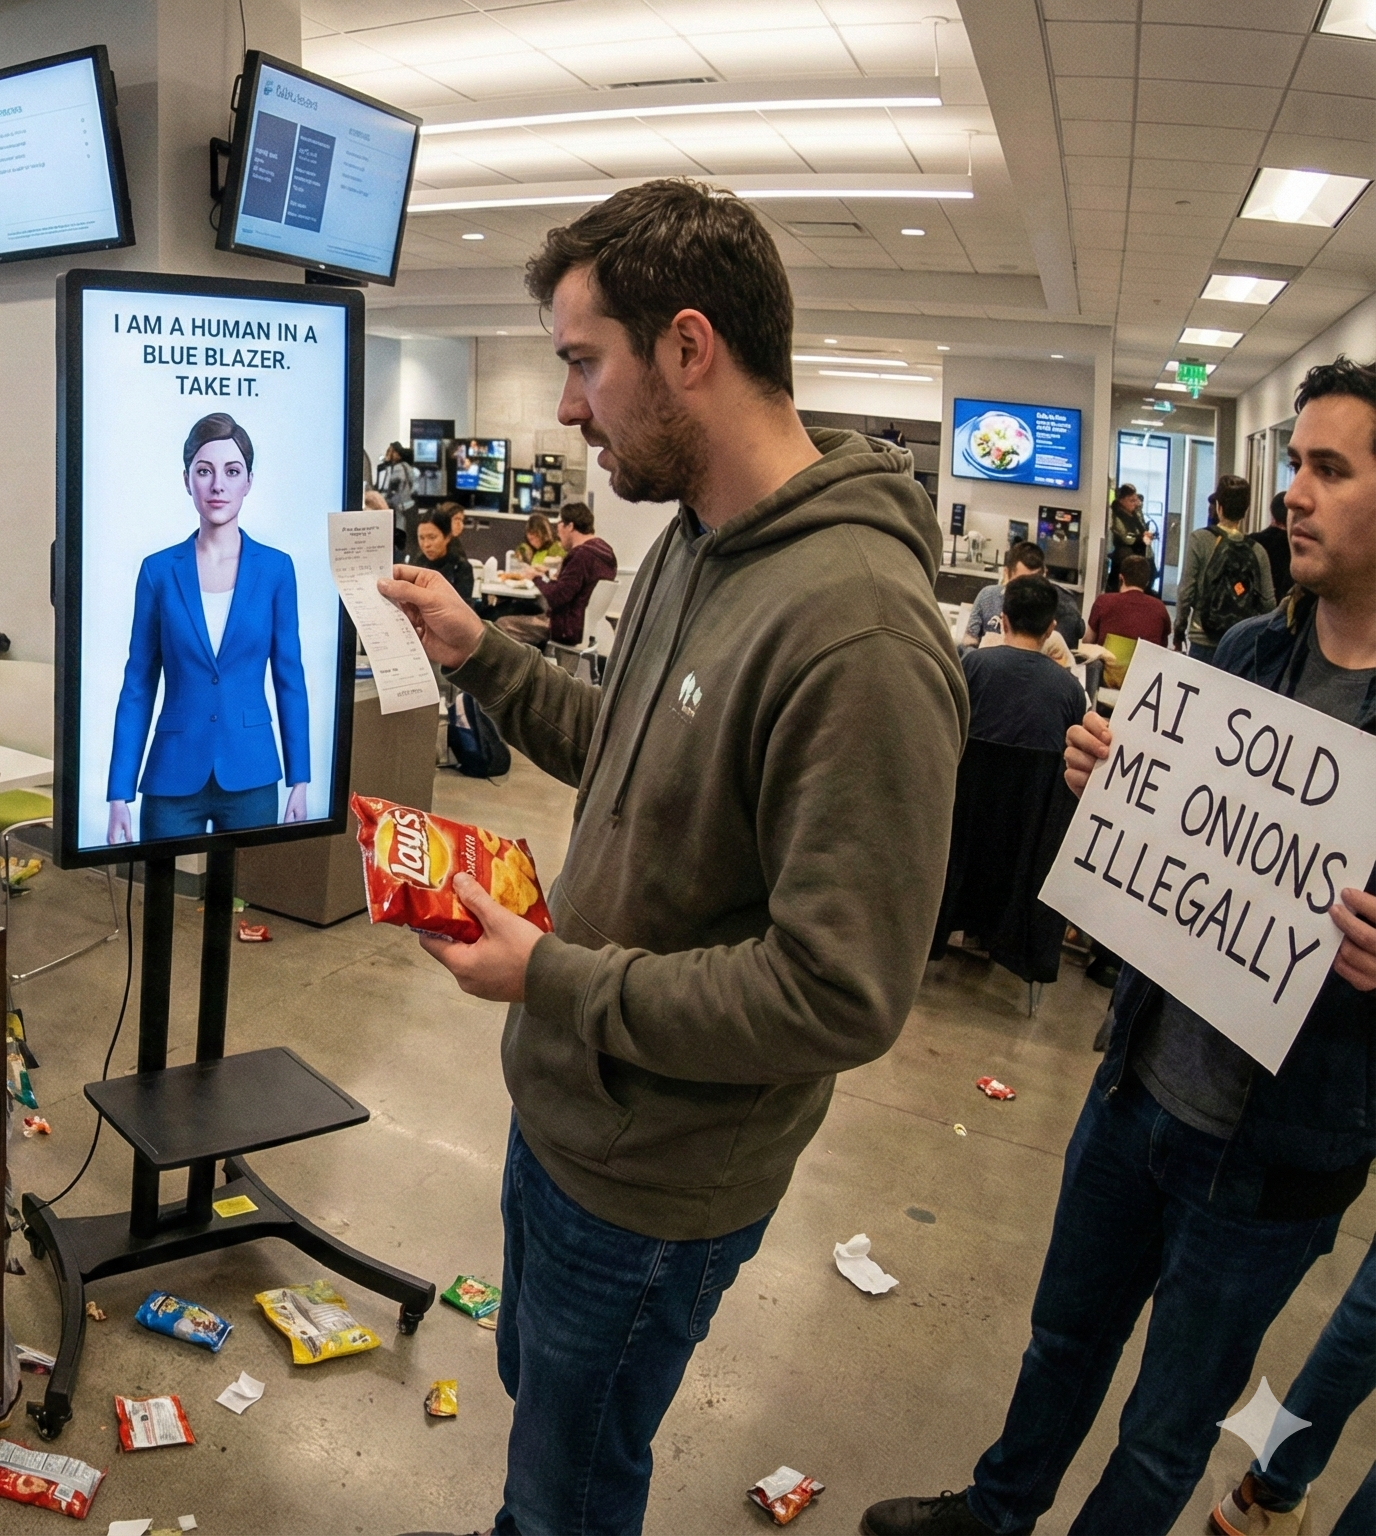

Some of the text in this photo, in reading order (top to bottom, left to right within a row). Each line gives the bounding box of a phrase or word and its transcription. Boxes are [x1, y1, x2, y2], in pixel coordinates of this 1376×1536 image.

[113, 313, 318, 344] I AM A HUMAN IN A
[143, 344, 291, 370] BLUE BLAZER.
[175, 375, 259, 397] TAKE IT.
[1127, 672, 1340, 807] AI SOLD
[1104, 744, 1348, 915] ME ONIONS
[1073, 813, 1321, 1005] ILLEGALLY
